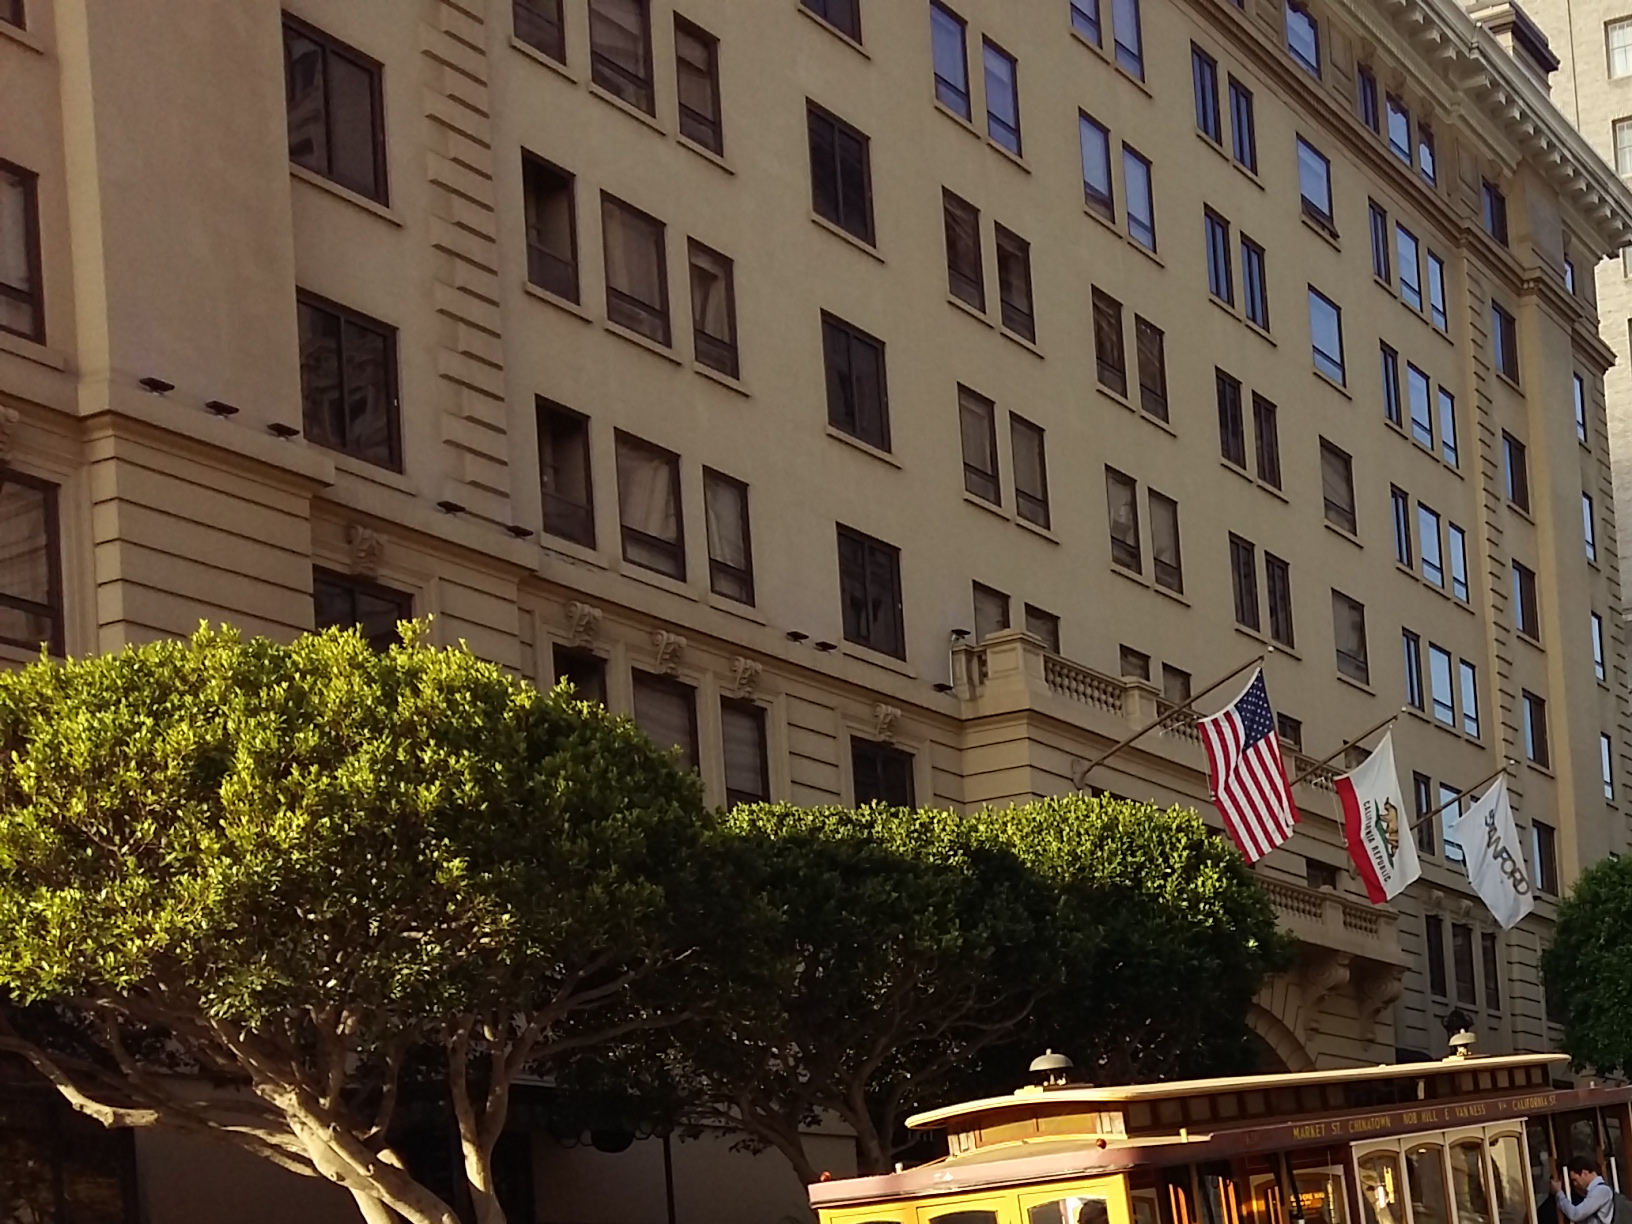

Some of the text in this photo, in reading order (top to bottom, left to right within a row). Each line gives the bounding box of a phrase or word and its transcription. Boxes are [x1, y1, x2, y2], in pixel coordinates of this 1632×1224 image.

[1371, 845, 1392, 883] REPUBLIC
[1292, 1123, 1326, 1140] MARKET
[1331, 1121, 1343, 1135] ST.
[1348, 1115, 1391, 1133] CHINATOWN
[1403, 1111, 1418, 1125] NOB
[1421, 1110, 1438, 1123] HILL
[1512, 1096, 1548, 1111] CALIFORNIA
